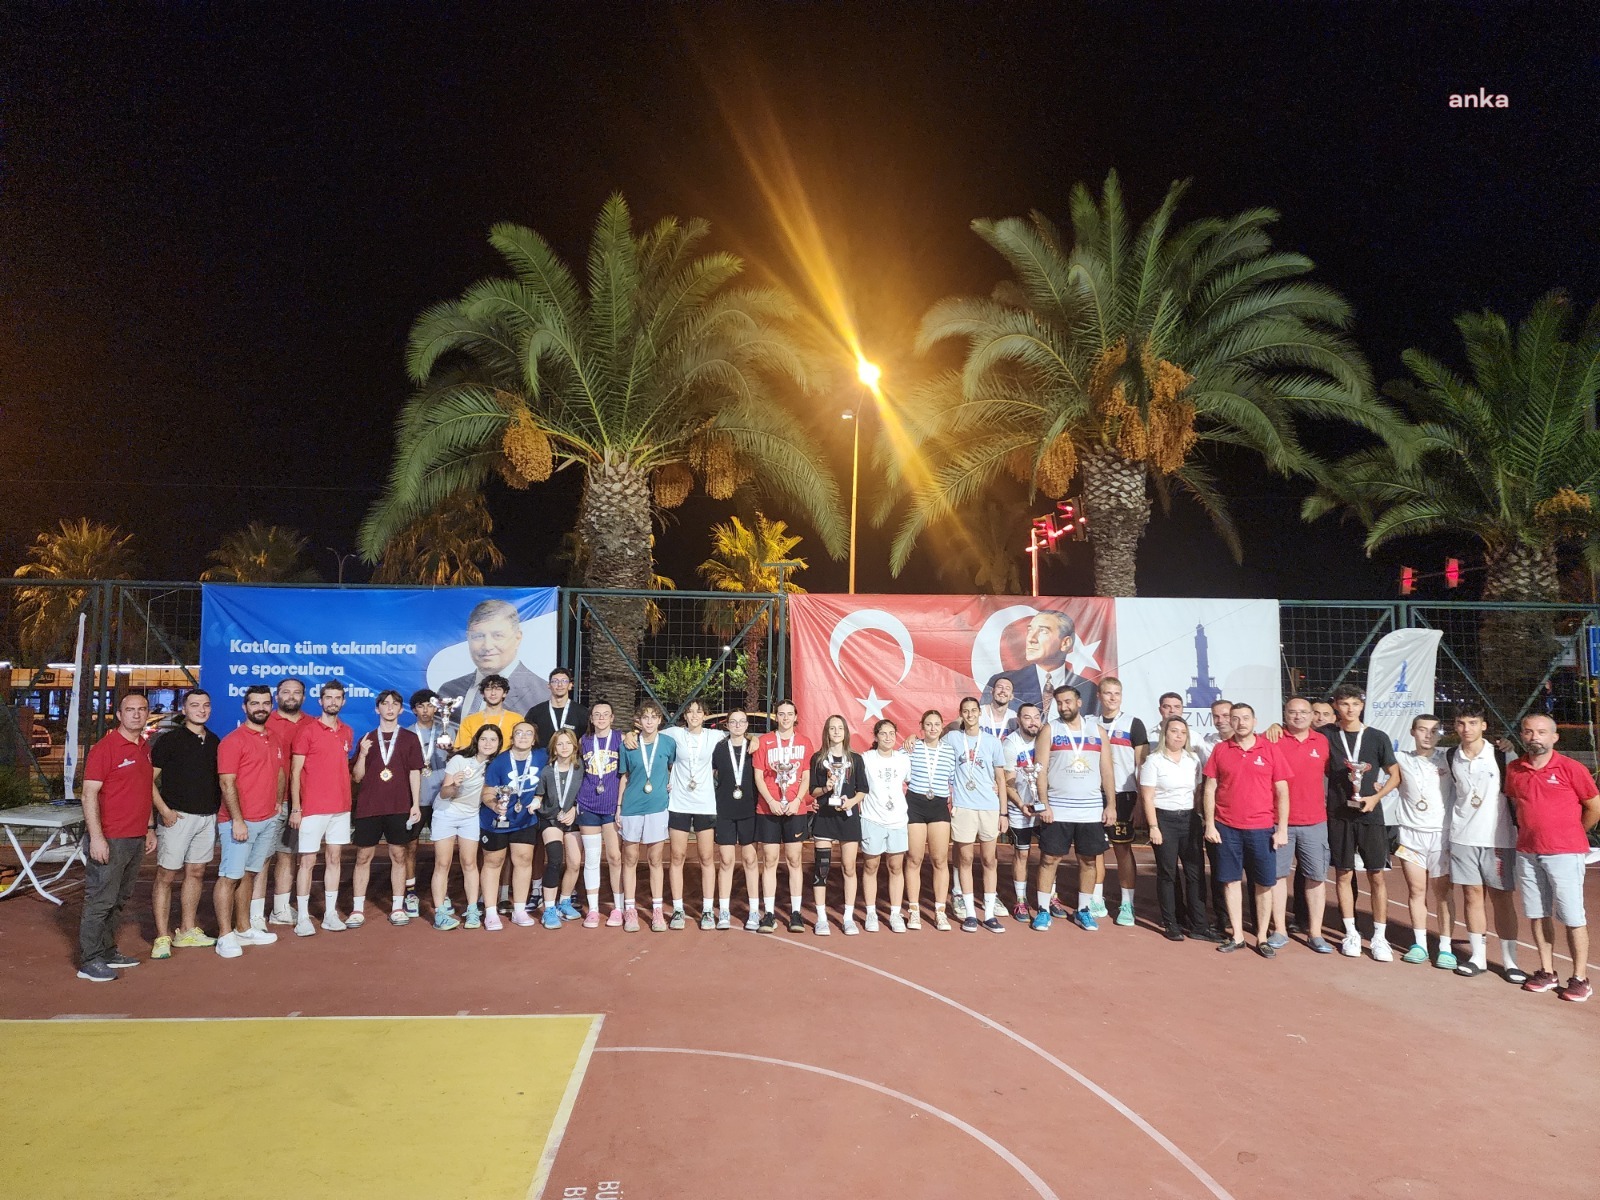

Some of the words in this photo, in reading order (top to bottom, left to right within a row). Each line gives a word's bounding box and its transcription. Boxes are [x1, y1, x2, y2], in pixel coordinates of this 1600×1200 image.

[230, 639, 290, 654] Katılan
[294, 641, 328, 655] tüm
[331, 640, 417, 655] takımlara
[229, 664, 248, 675] ve
[251, 661, 344, 678] sporculara
[1115, 826, 1127, 836] 24
